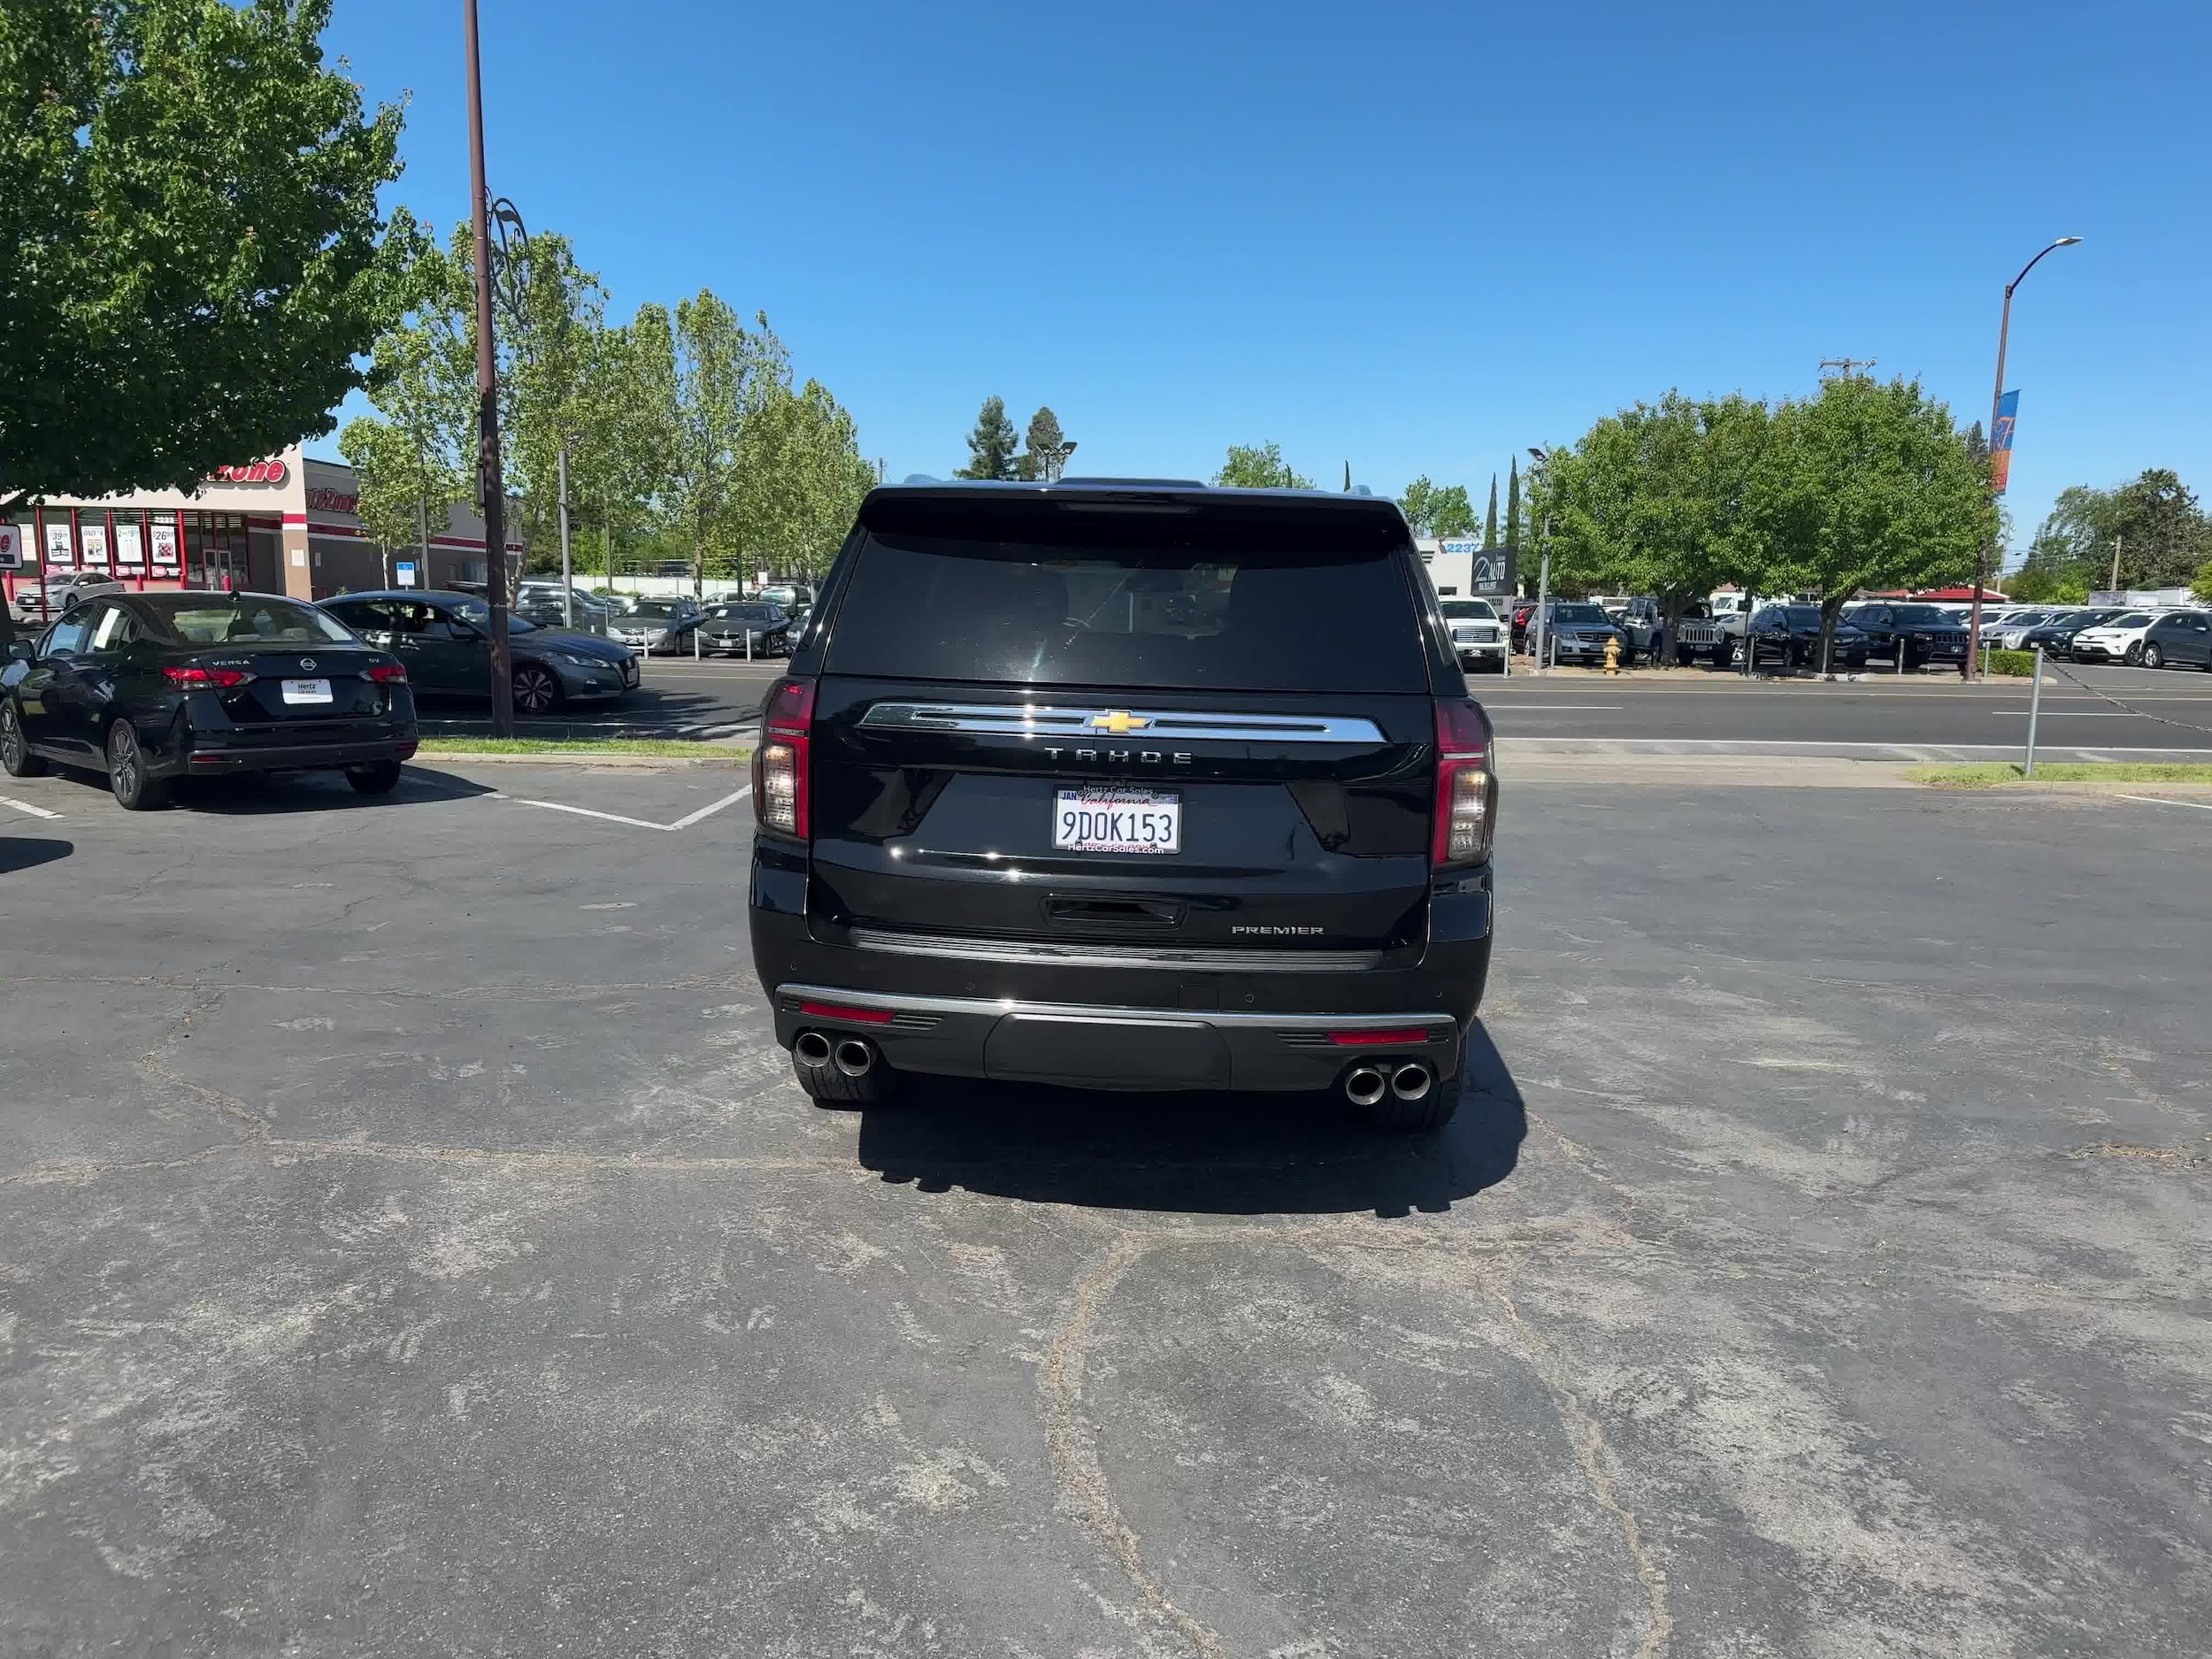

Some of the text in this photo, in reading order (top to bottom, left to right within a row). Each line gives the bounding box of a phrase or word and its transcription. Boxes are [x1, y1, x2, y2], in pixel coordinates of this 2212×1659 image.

[1487, 562, 1506, 581] AUTO
[1045, 748, 1192, 764] TAHOE
[1062, 792, 1078, 801] JAN
[1084, 785, 1106, 794] Hertz
[1081, 791, 1157, 810] California
[1062, 811, 1172, 842] 9DOK153
[1068, 843, 1164, 855] HertzCarSales.com
[1232, 926, 1325, 935] PREMIER
